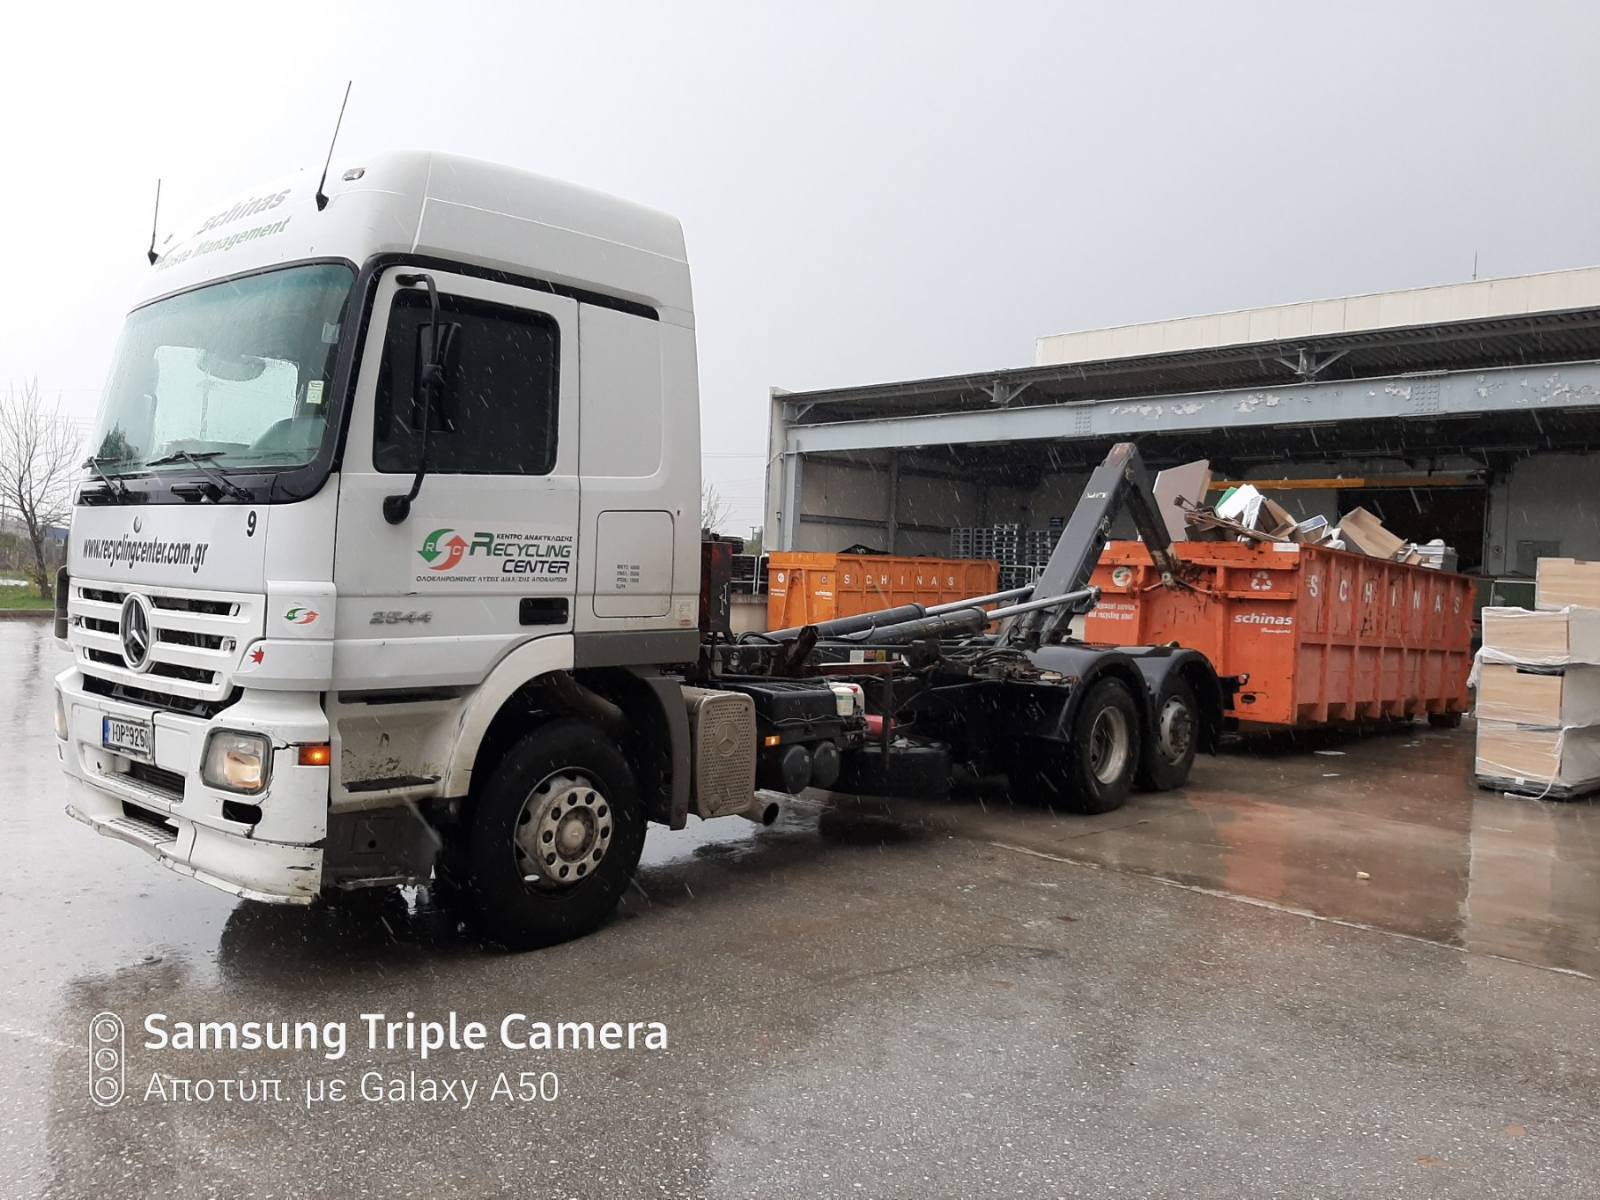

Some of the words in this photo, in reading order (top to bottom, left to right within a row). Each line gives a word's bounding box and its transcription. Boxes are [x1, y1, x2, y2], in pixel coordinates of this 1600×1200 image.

[196, 188, 291, 236] schinas
[193, 216, 292, 257] Management
[247, 510, 257, 538] 9
[496, 533, 523, 541] ΚΕΝΤΡΟ
[83, 534, 209, 574] www.recyclingcenter.com.gr
[502, 559, 570, 574] CENTER
[843, 574, 954, 586] SCHINAS
[1309, 575, 1463, 614] SCHINAS
[369, 611, 432, 624] 2544
[1234, 612, 1293, 625] schinas
